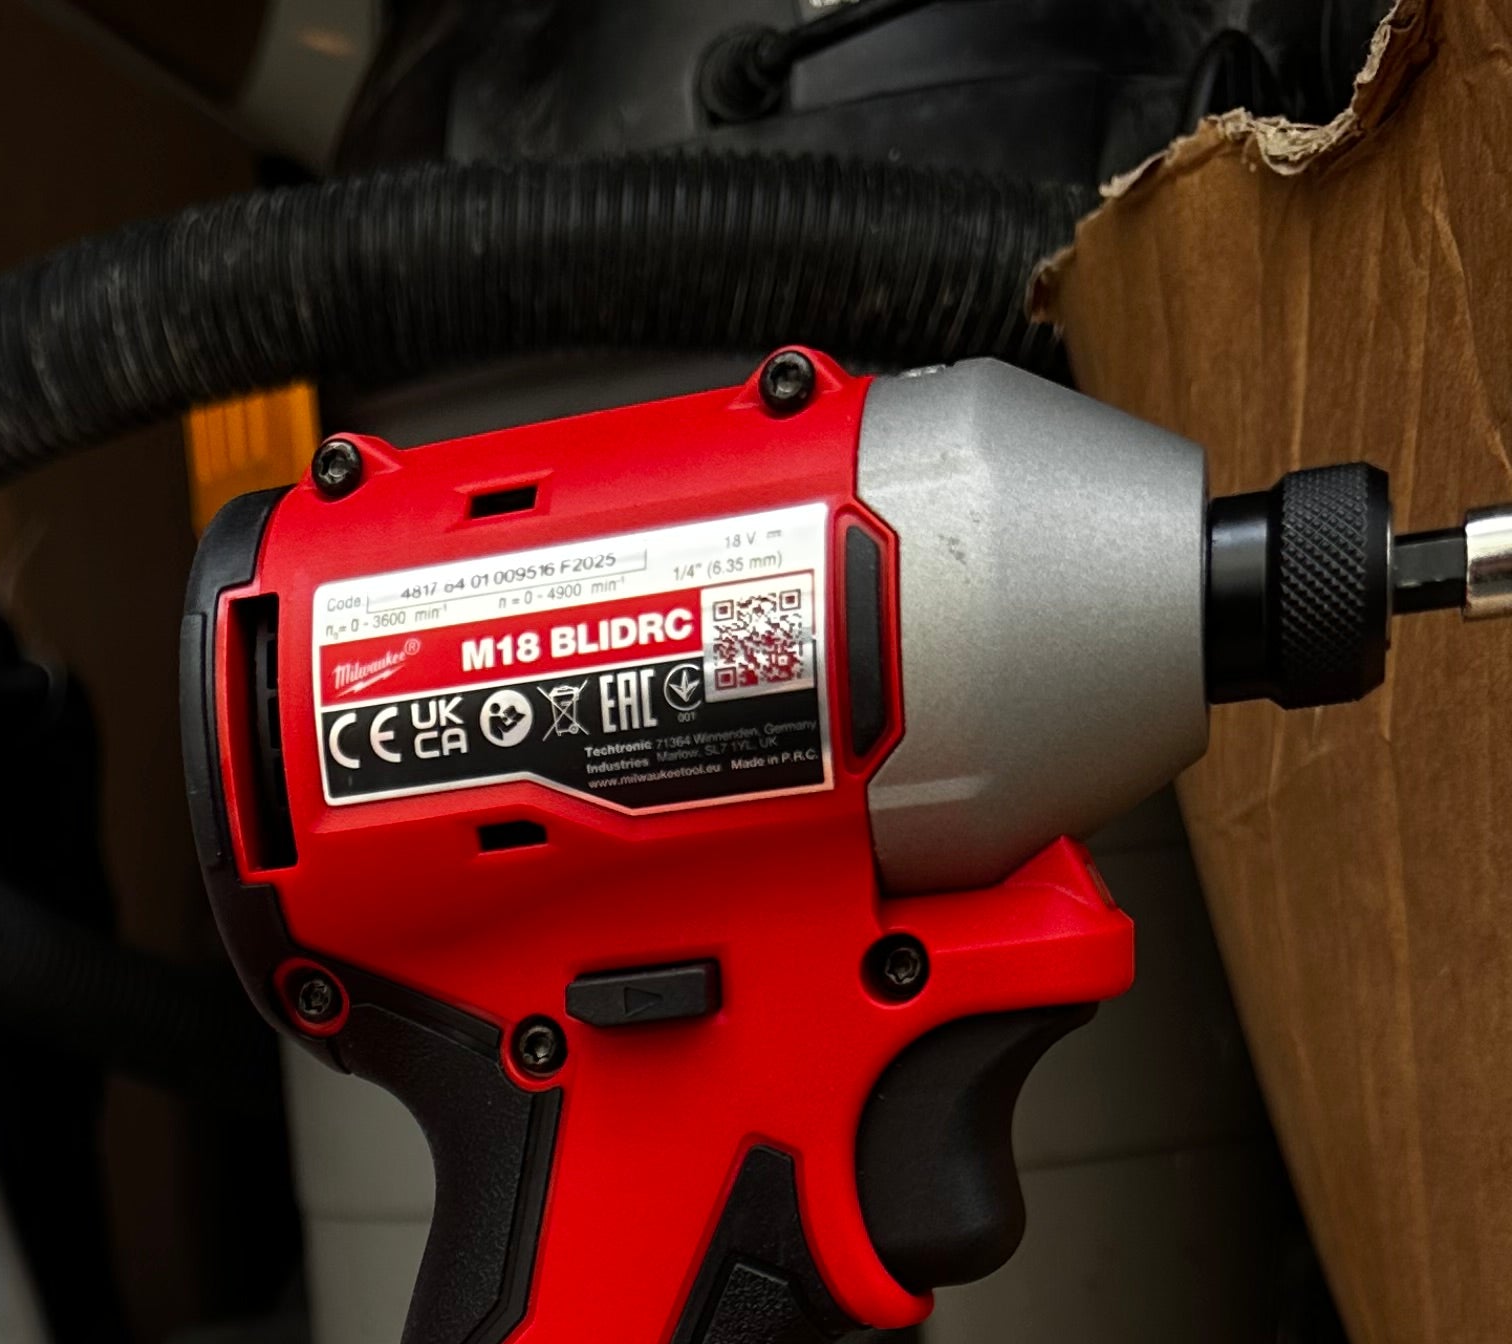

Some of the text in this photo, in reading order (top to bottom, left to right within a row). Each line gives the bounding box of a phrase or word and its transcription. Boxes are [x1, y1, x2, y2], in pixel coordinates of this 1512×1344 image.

[725, 531, 757, 549] 18 V
[749, 550, 783, 570] mm)
[327, 596, 361, 612] Code
[401, 582, 438, 599] 4817
[494, 562, 555, 585] 009516
[561, 552, 616, 573] F2025
[547, 583, 582, 601] 4900
[373, 611, 406, 629] 3600
[461, 607, 693, 672] M18 BLIDRC
[599, 668, 658, 733] EAC
[411, 696, 464, 729] UK
[329, 706, 402, 769] CE
[764, 720, 816, 736] Germany
[414, 727, 468, 759] CA
[584, 741, 652, 758] Techtronic
[587, 758, 649, 774] Industries
[731, 757, 765, 771] Made
[767, 754, 779, 767] in
